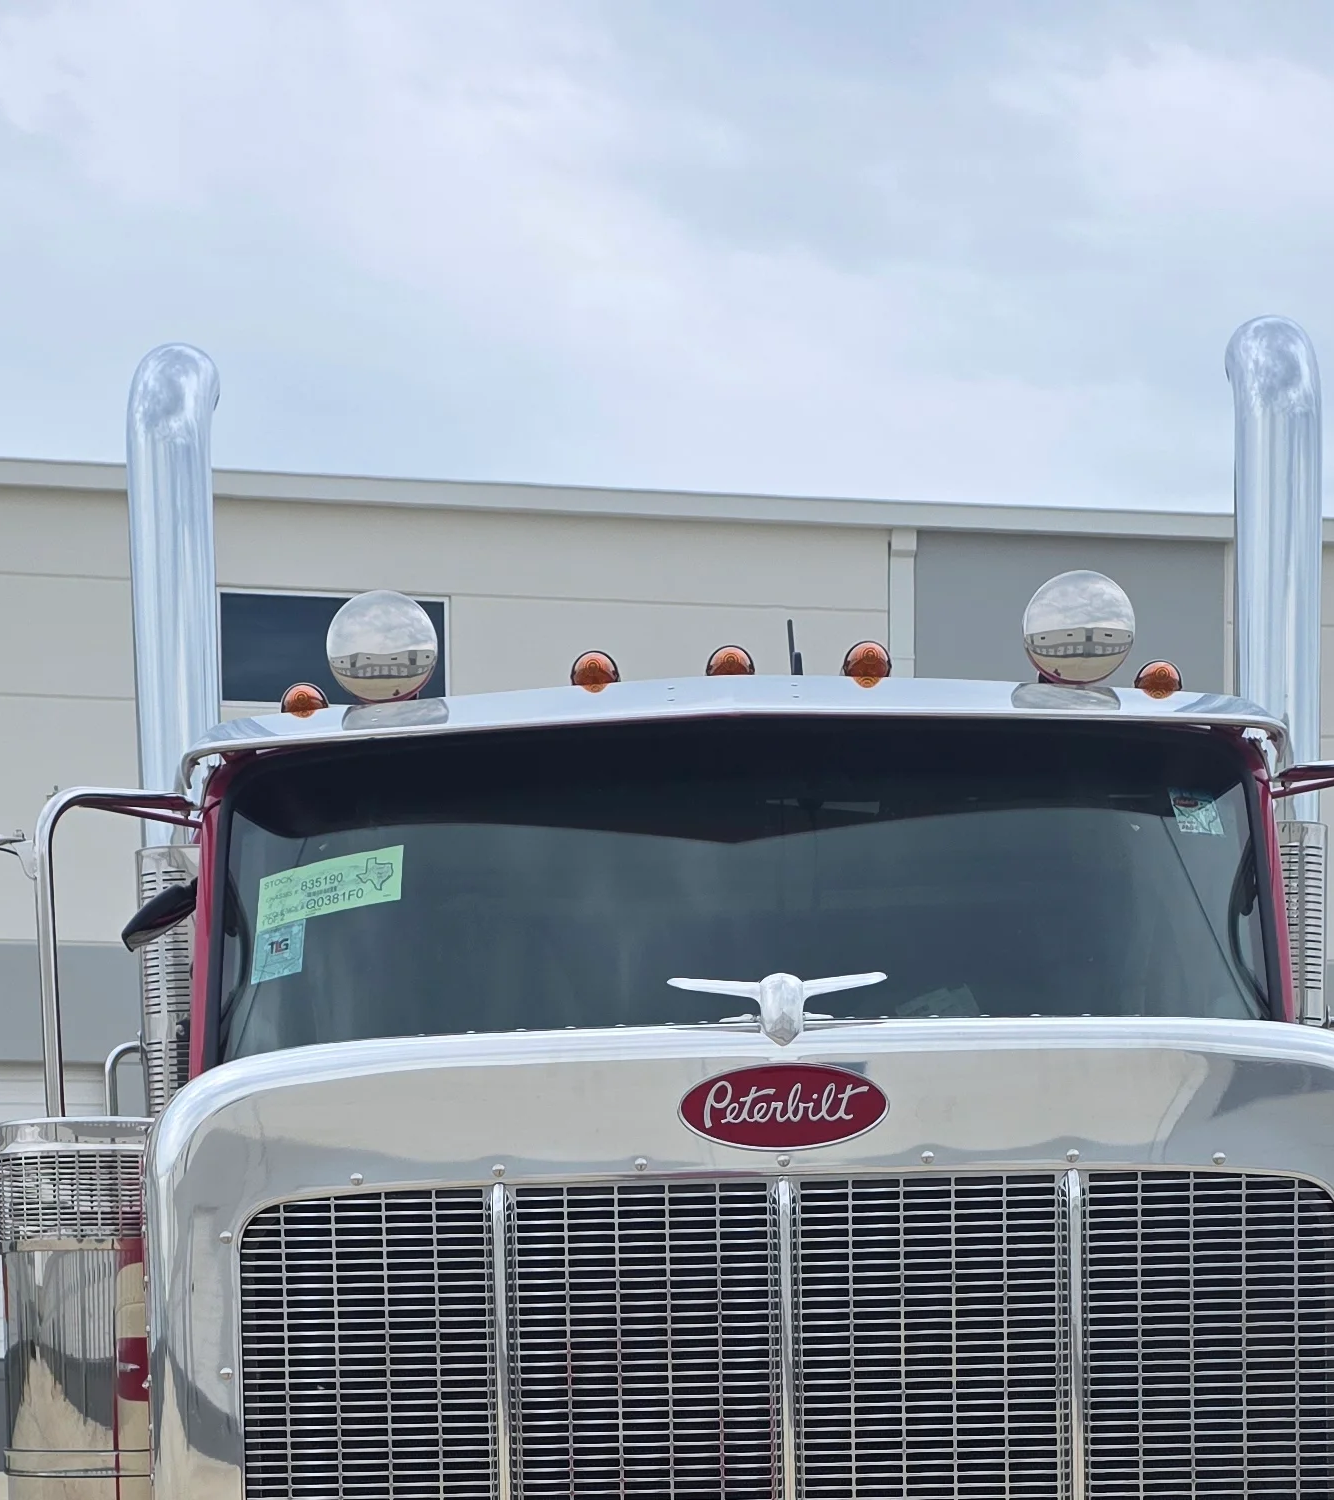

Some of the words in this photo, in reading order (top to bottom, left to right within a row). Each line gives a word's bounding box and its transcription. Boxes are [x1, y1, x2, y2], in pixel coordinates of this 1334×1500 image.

[263, 875, 293, 890] STOCK
[300, 872, 344, 892] 835190
[306, 887, 364, 910] Q0381F0
[703, 1080, 870, 1129] Peterbilt
